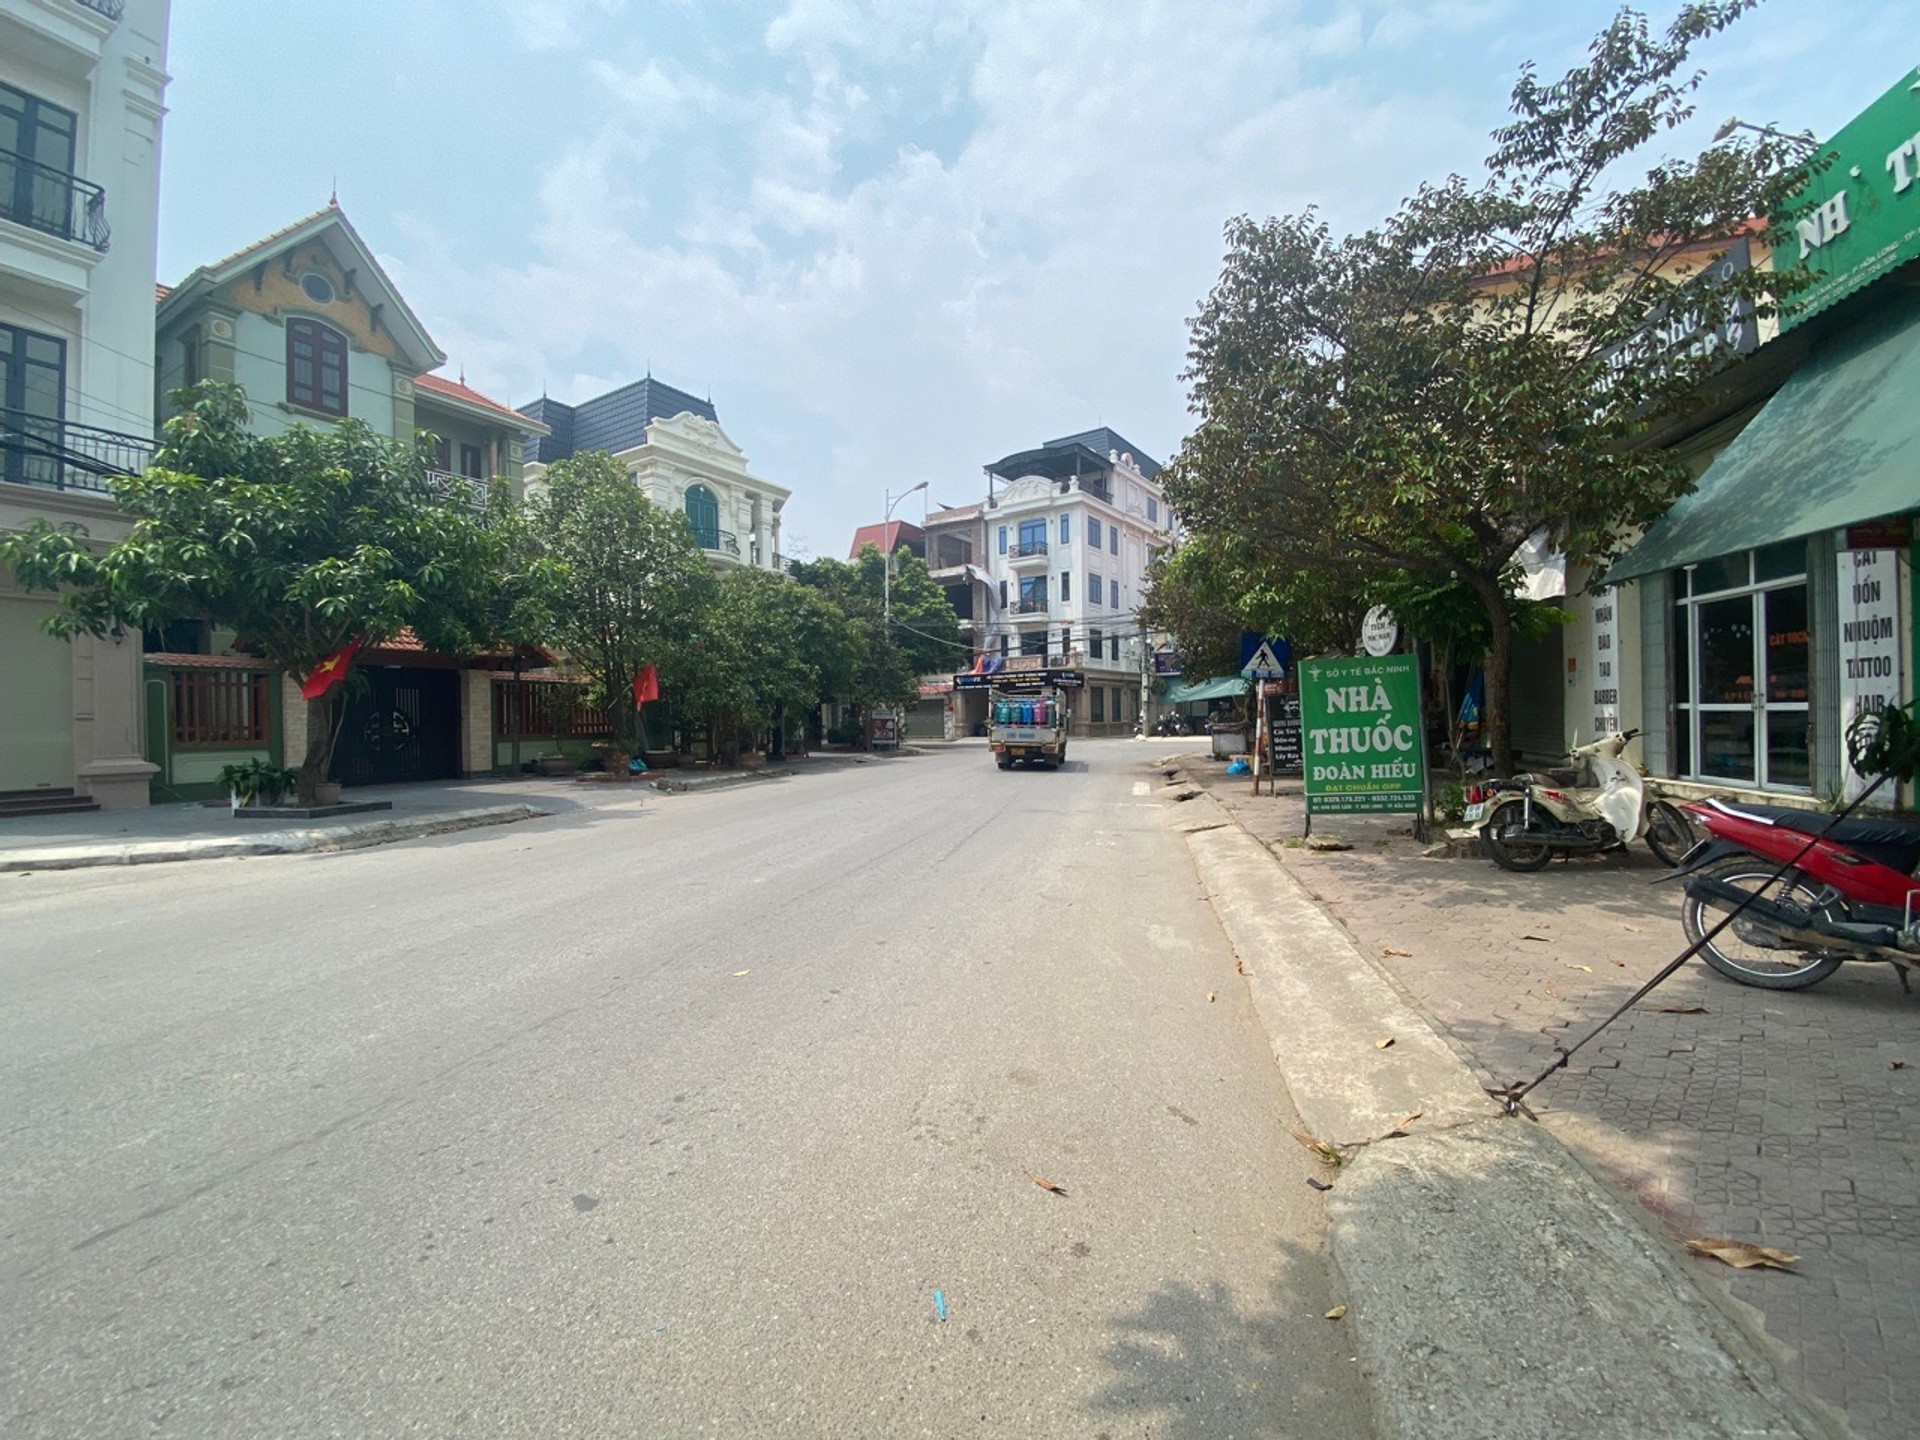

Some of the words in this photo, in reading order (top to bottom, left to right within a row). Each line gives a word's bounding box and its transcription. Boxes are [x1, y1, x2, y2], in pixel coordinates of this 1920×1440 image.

[1852, 574, 1881, 605] UỐN
[1843, 614, 1893, 645] NHUỘM
[1326, 668, 1339, 678] SỞ
[1341, 668, 1348, 677] Y
[1350, 666, 1362, 676] TẾ
[1364, 665, 1384, 675] BẮC
[1386, 665, 1410, 674] NINH
[1846, 655, 1892, 680] TATTOO
[1325, 677, 1393, 714] NHÀ
[1594, 688, 1618, 705] BARBER
[1309, 713, 1413, 755] THUỐC
[1312, 761, 1366, 781] ĐOÀN
[1371, 756, 1416, 779] HIẾU
